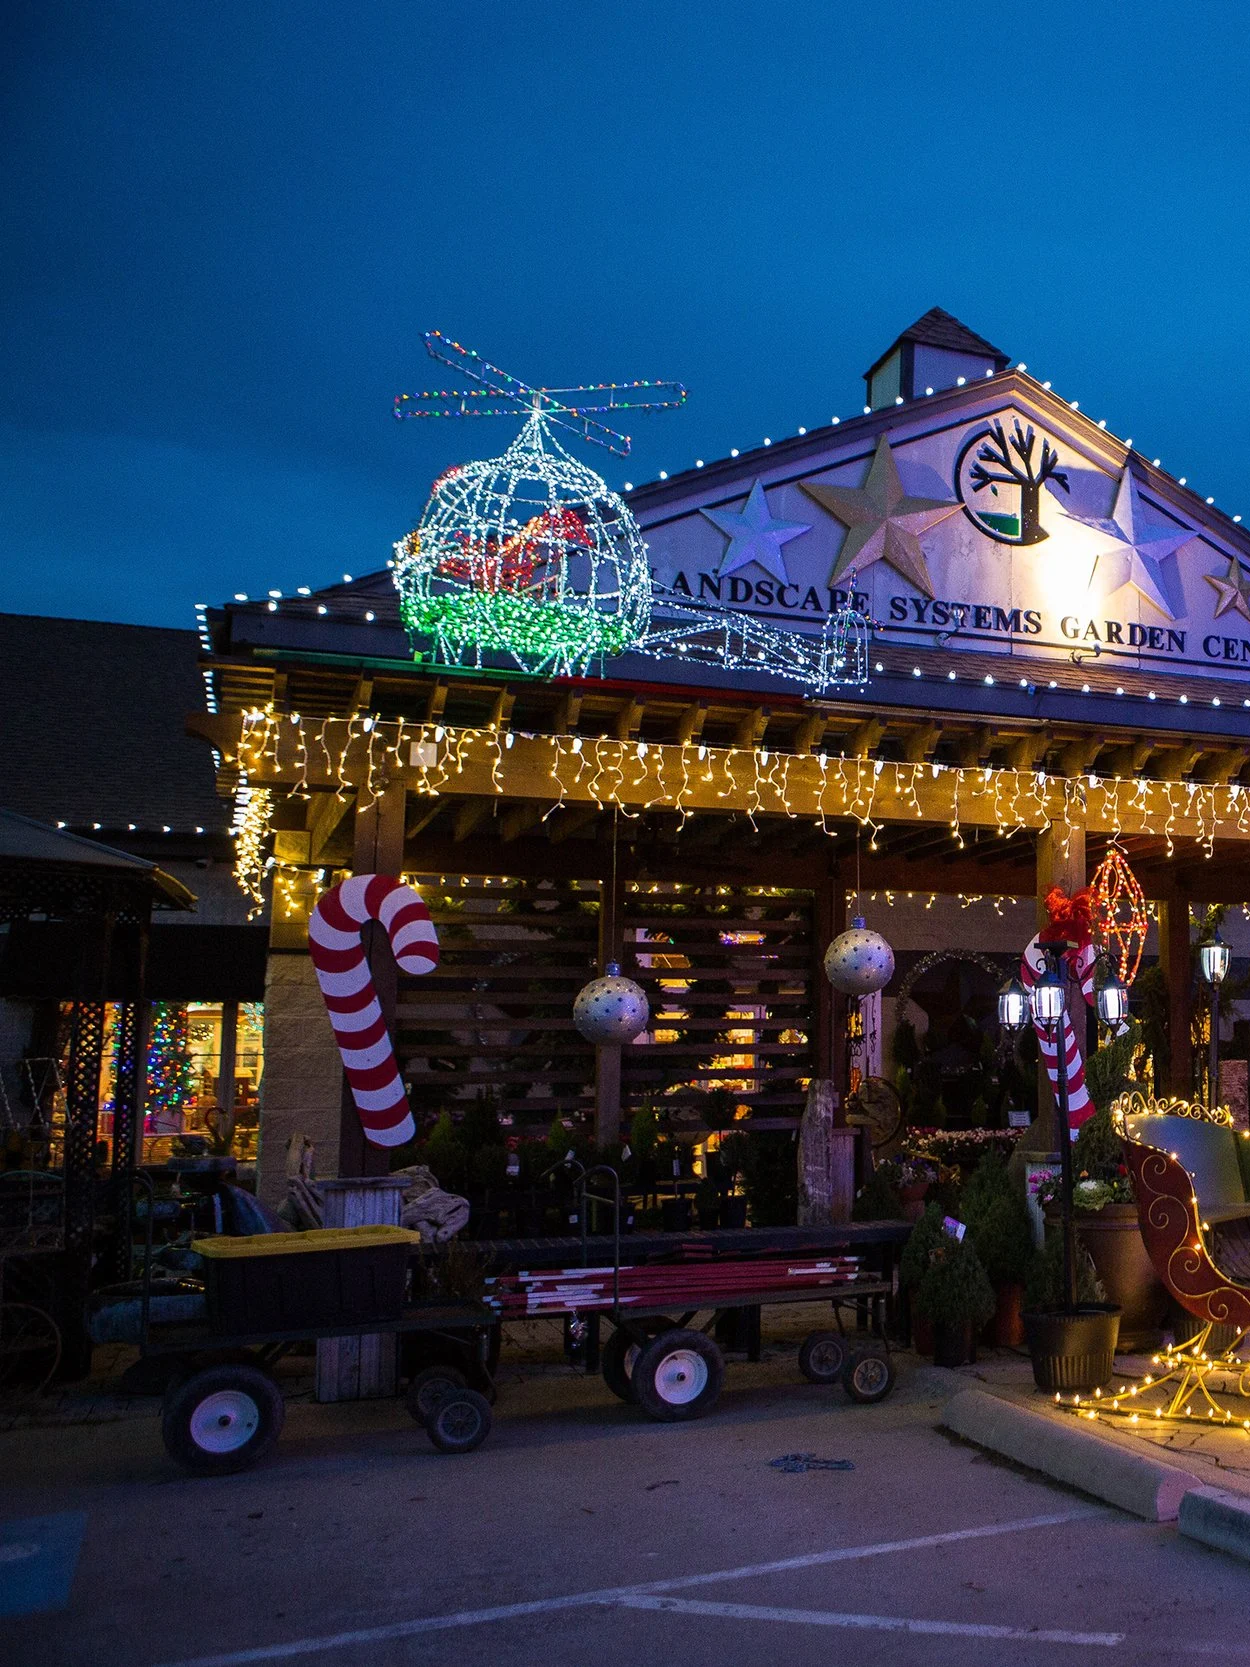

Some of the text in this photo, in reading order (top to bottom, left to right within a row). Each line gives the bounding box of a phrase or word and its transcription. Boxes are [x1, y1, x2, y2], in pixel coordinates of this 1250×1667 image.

[649, 567, 870, 615] LANDSCAPE
[889, 596, 1043, 635] SYSTEMS
[1060, 616, 1187, 653] GARDEN
